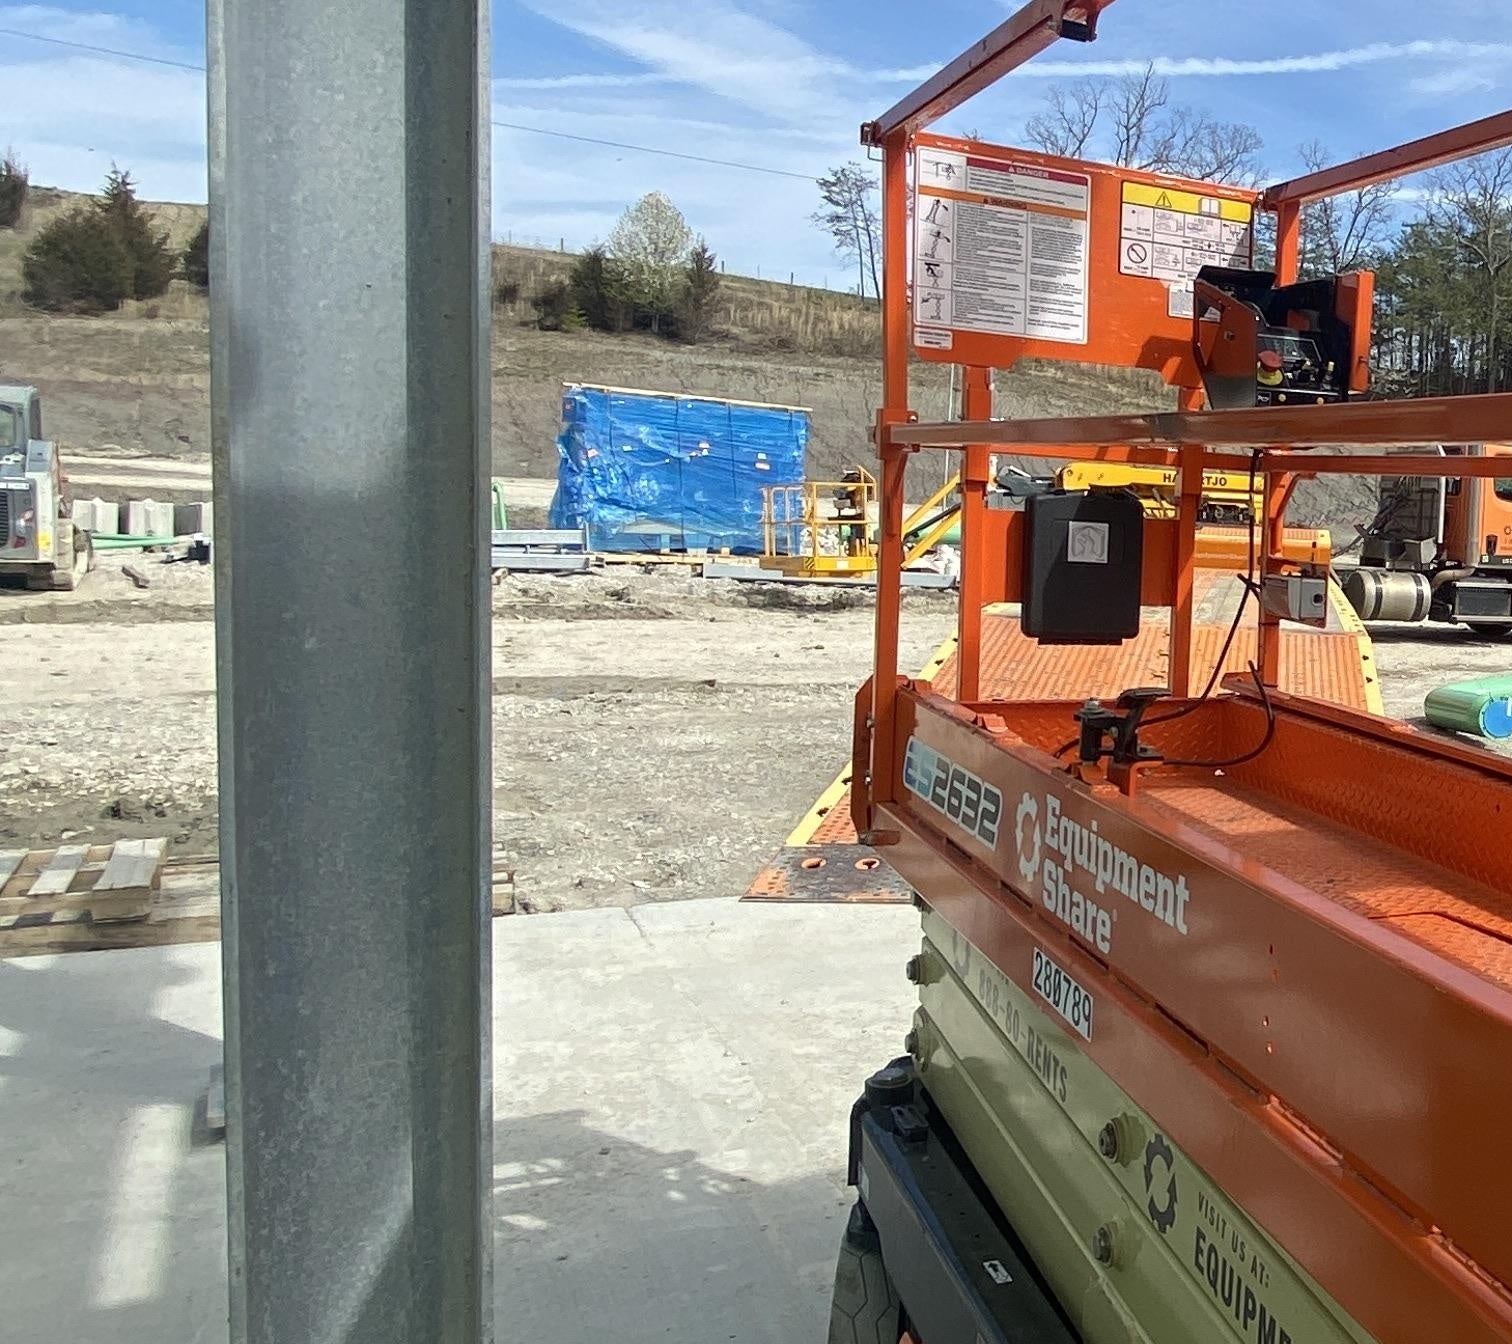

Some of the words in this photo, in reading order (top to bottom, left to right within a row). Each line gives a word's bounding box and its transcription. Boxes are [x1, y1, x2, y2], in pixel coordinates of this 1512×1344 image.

[1042, 860, 1113, 954] Share
[1044, 793, 1190, 935] Equipment
[979, 969, 1068, 1103] 888-80-RENTS
[1034, 951, 1092, 1035] 280789
[1198, 1191, 1227, 1239] VISIT
[1231, 1230, 1246, 1262] US
[1251, 1255, 1269, 1288] AT:
